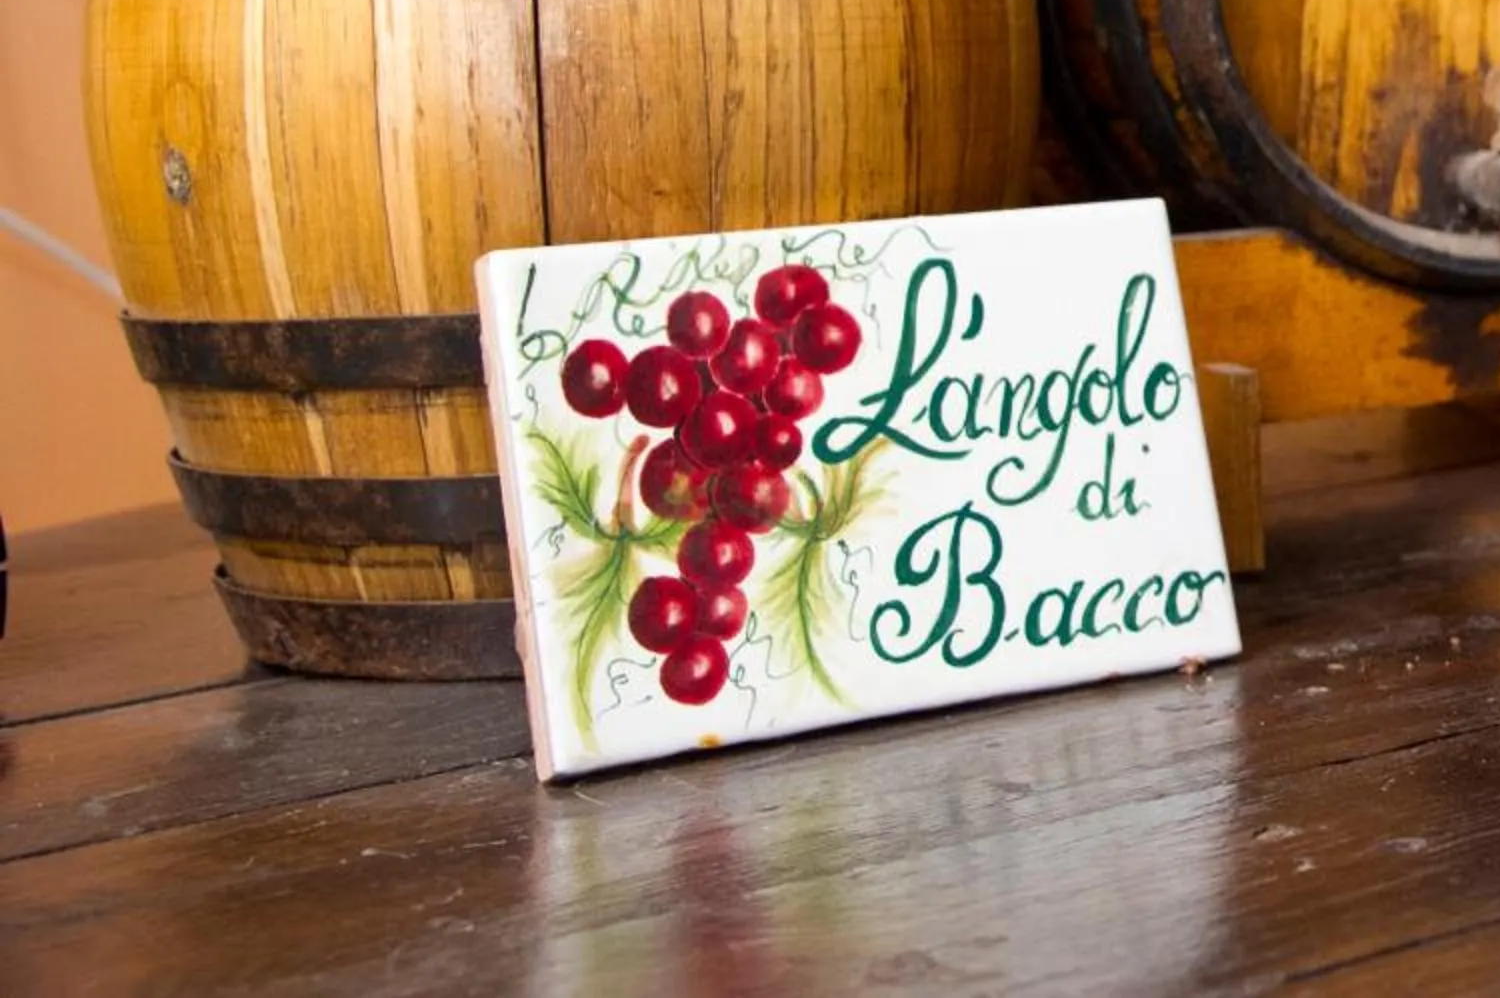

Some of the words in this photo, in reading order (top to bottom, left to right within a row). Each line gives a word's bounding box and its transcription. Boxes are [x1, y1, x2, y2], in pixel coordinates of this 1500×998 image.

[811, 258, 1196, 507] L'angolo
[1077, 432, 1151, 521] di
[870, 502, 1226, 668] Bacco
